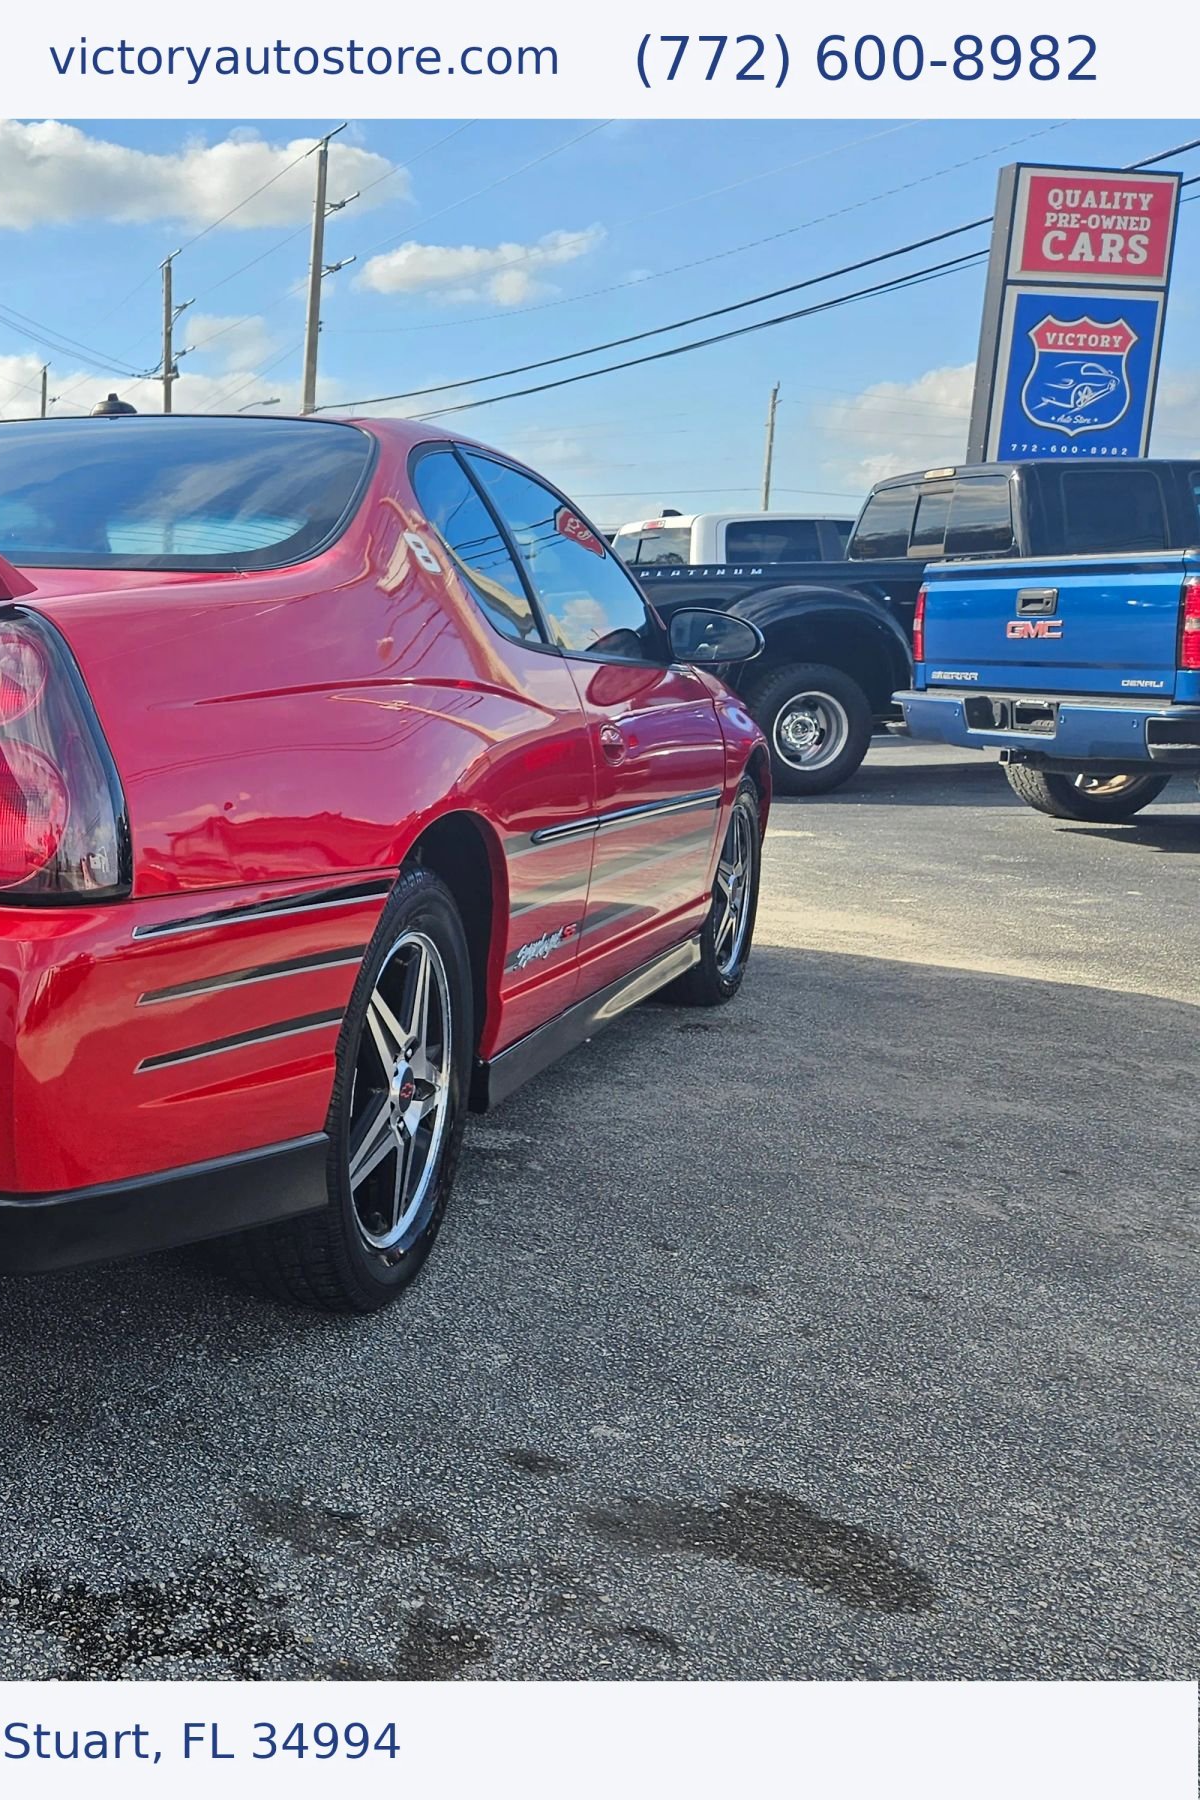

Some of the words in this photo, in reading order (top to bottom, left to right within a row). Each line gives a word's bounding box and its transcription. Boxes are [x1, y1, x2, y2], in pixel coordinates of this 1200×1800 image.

[1047, 188, 1154, 211] QUALITY
[1044, 212, 1152, 232] PRE-OWNED
[1041, 230, 1150, 265] CARS
[1046, 332, 1124, 348] VICTORY
[639, 568, 763, 578] PLATINUM
[1006, 619, 1063, 639] GMC
[931, 671, 979, 681] SIERRA
[1121, 679, 1164, 688] DENALI
